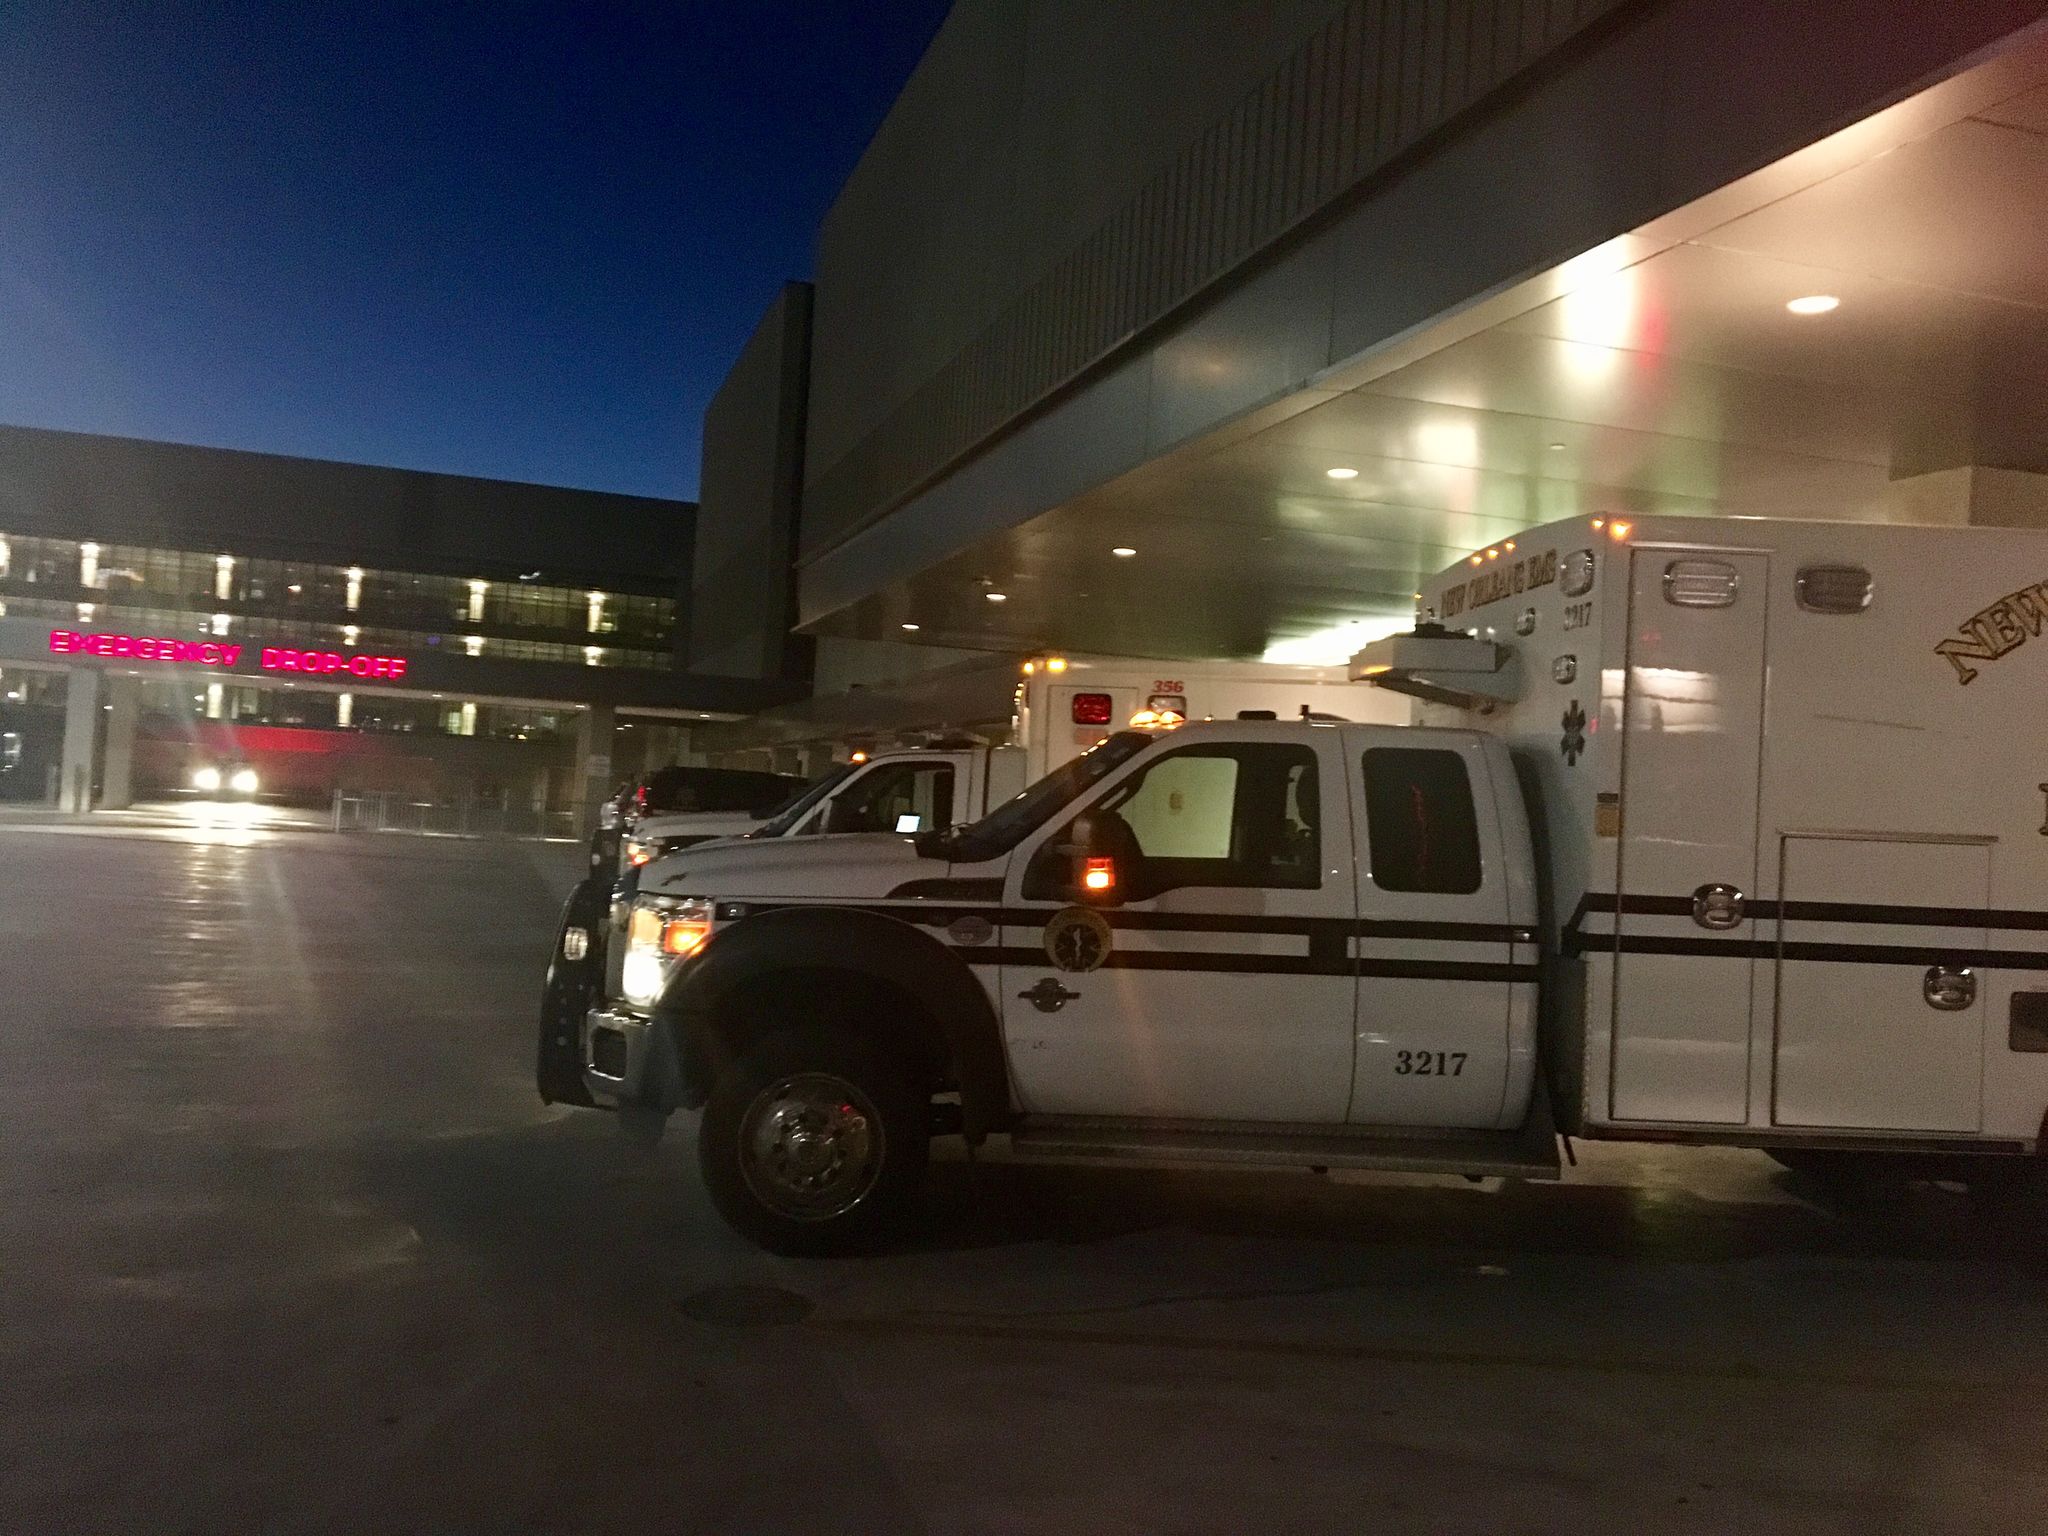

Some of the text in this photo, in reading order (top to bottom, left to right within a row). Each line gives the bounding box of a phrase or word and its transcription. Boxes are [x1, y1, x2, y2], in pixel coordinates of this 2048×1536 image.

[1563, 602, 1592, 631] 3217
[50, 630, 406, 678] EMERGENCY DROP-OFF
[1152, 680, 1185, 693] 356
[1395, 1050, 1468, 1076] 3217
